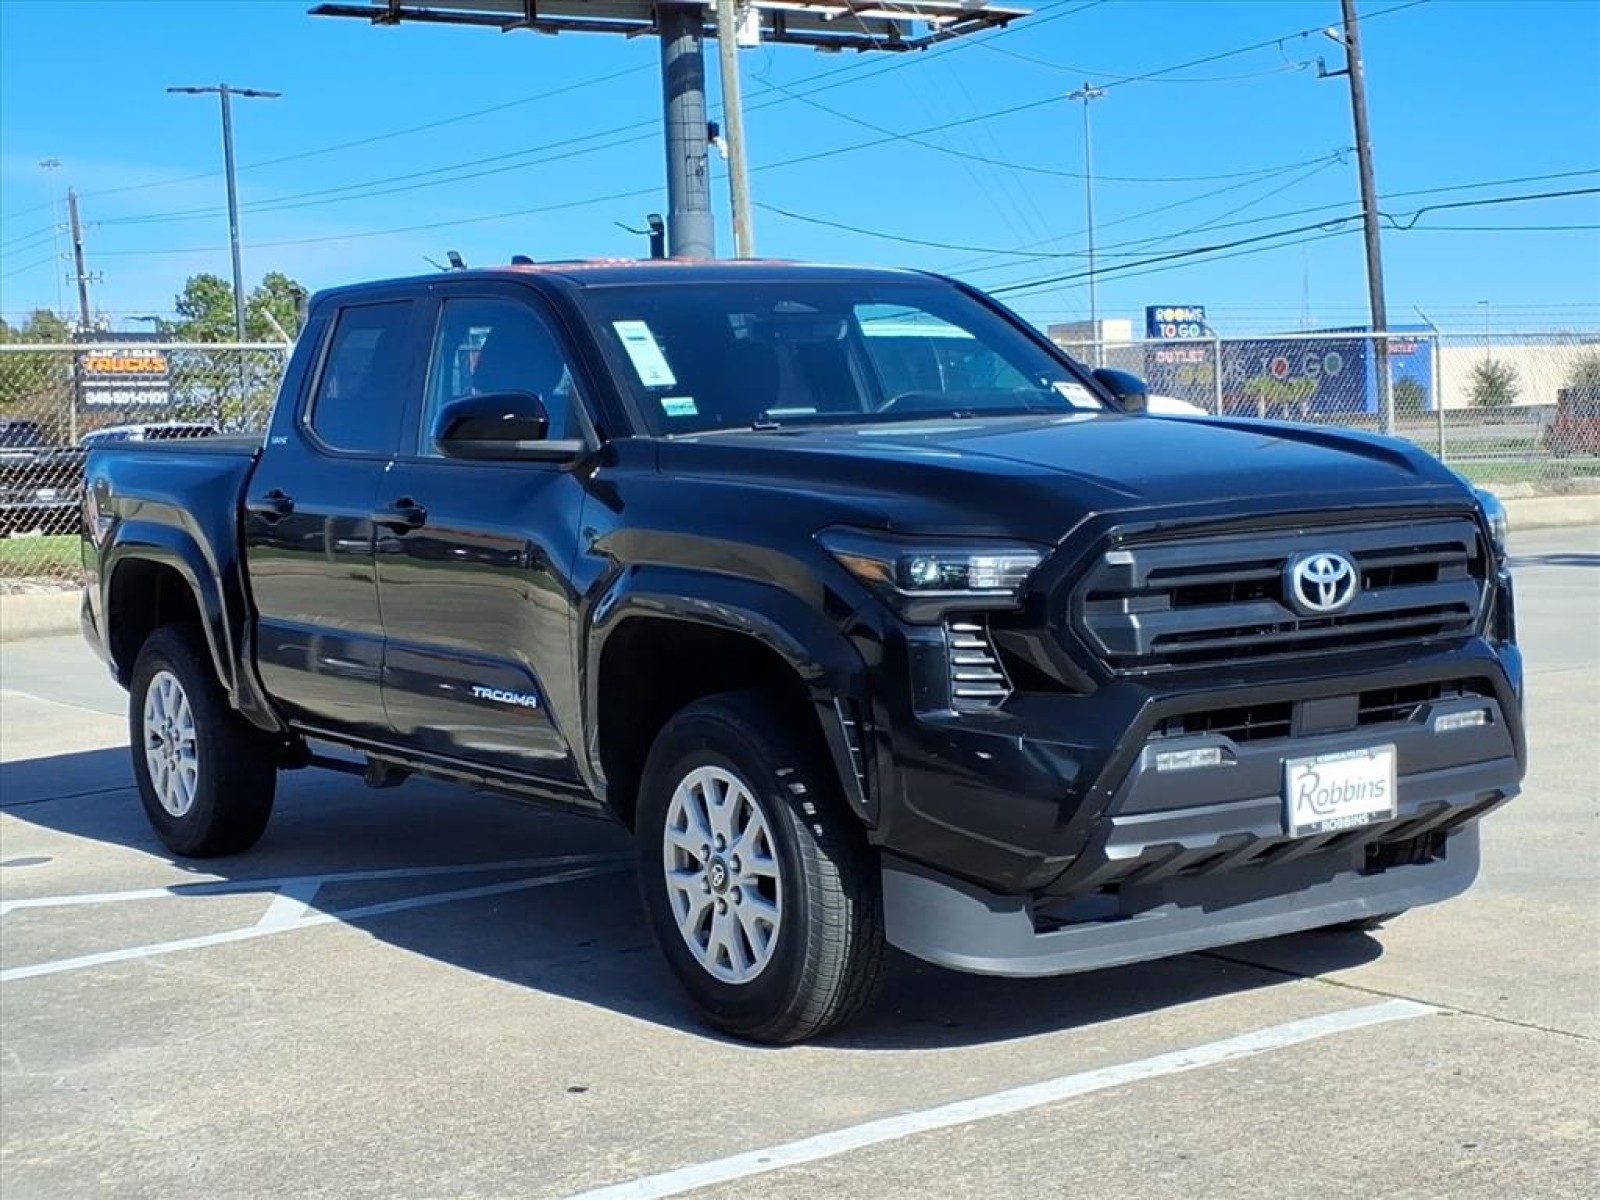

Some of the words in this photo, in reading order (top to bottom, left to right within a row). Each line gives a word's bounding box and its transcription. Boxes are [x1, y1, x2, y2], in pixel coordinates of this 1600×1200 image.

[1156, 307, 1204, 322] ROOMS
[1158, 323, 1177, 337] TO
[1179, 323, 1201, 338] GO
[84, 356, 168, 375] TRUCKS
[1155, 350, 1205, 363] OUTLET
[471, 685, 537, 709] TACOMA
[1297, 772, 1386, 815] Robbins
[1321, 813, 1370, 832] ROBBINS
